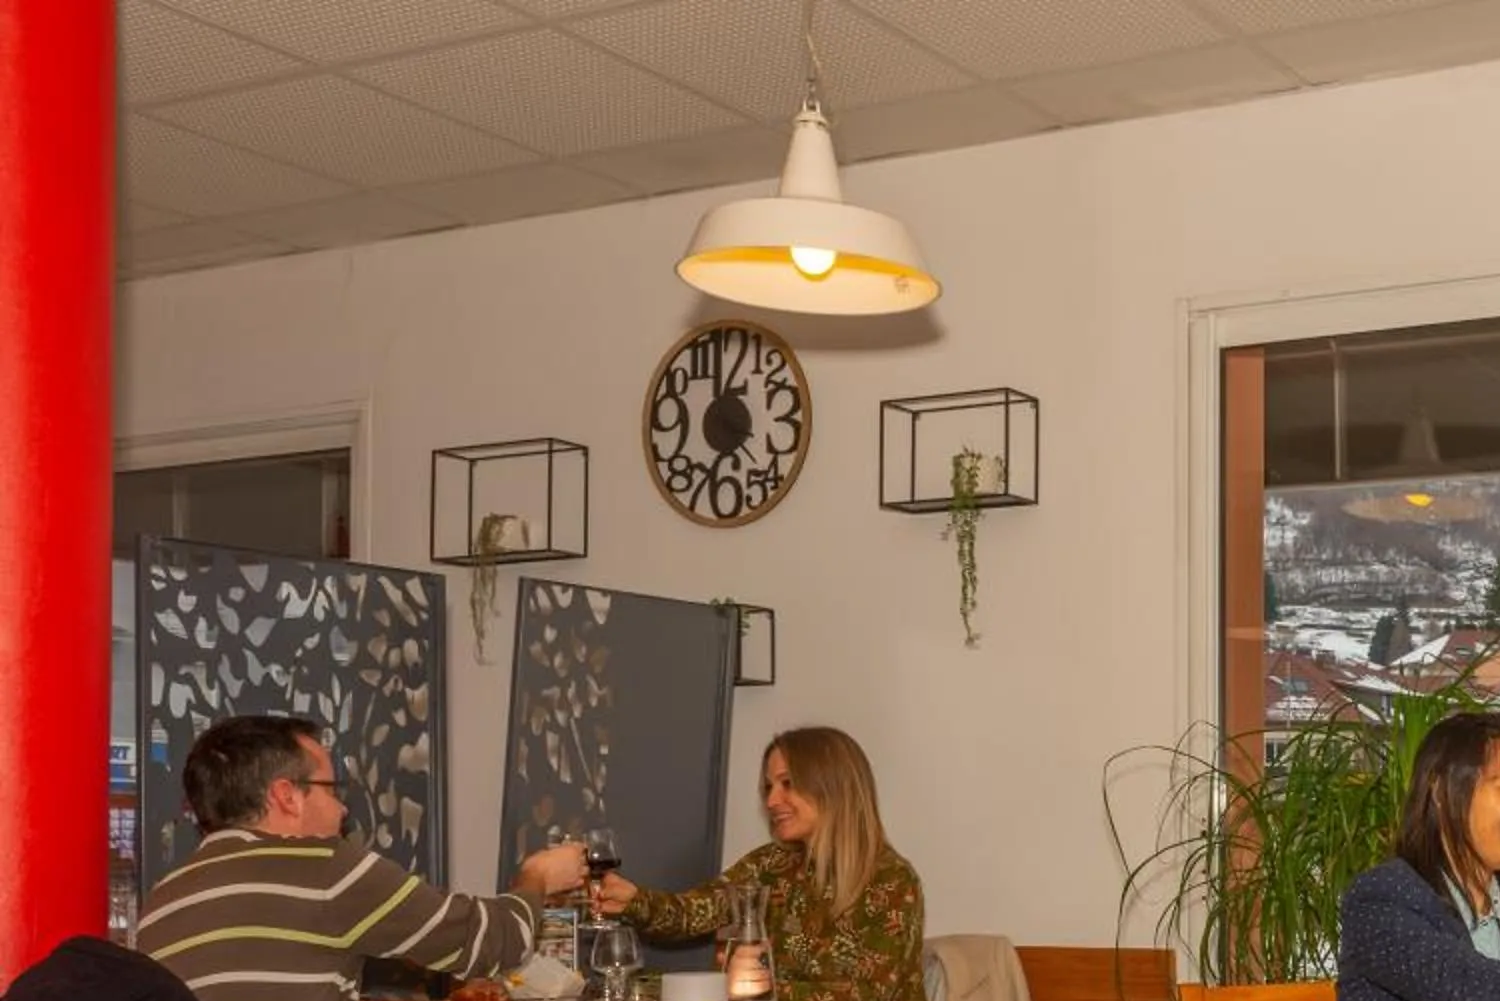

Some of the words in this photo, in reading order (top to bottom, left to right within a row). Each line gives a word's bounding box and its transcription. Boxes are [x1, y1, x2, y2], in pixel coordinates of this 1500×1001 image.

[687, 336, 716, 381] 11
[711, 327, 749, 397] 12
[751, 333, 764, 375] 1
[764, 349, 788, 388] 2
[652, 394, 690, 462] 9
[766, 383, 802, 455] 3
[667, 455, 693, 492] 8
[689, 462, 712, 512] 7
[709, 450, 744, 519] 6
[745, 468, 769, 510] 5
[765, 453, 785, 490] 4
